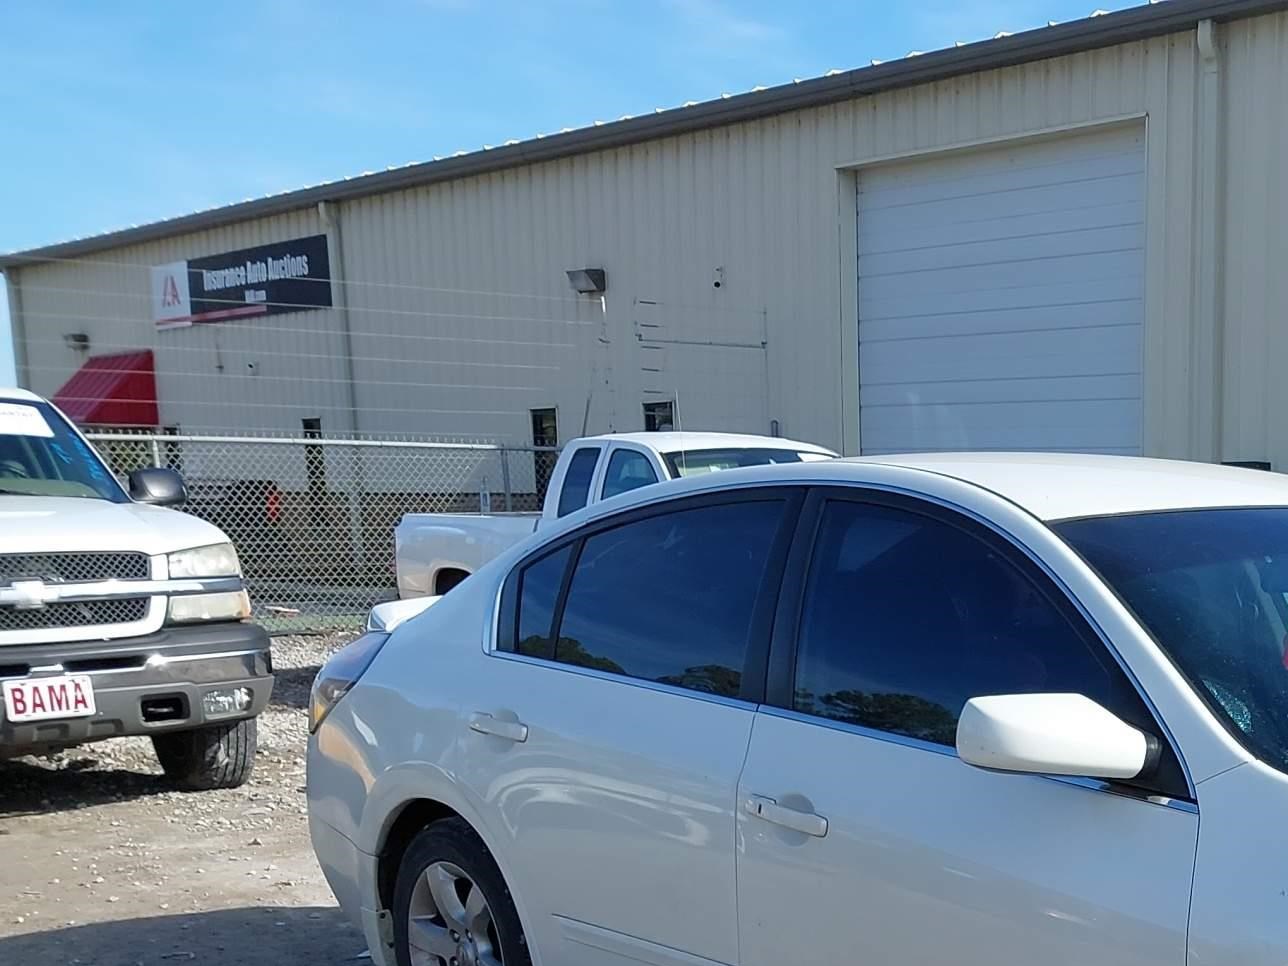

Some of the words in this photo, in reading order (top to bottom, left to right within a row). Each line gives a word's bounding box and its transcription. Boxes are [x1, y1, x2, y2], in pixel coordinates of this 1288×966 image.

[202, 265, 246, 291] Insurance
[246, 260, 267, 284] Auto
[267, 254, 309, 281] Auctions
[10, 682, 89, 715] BAMA
